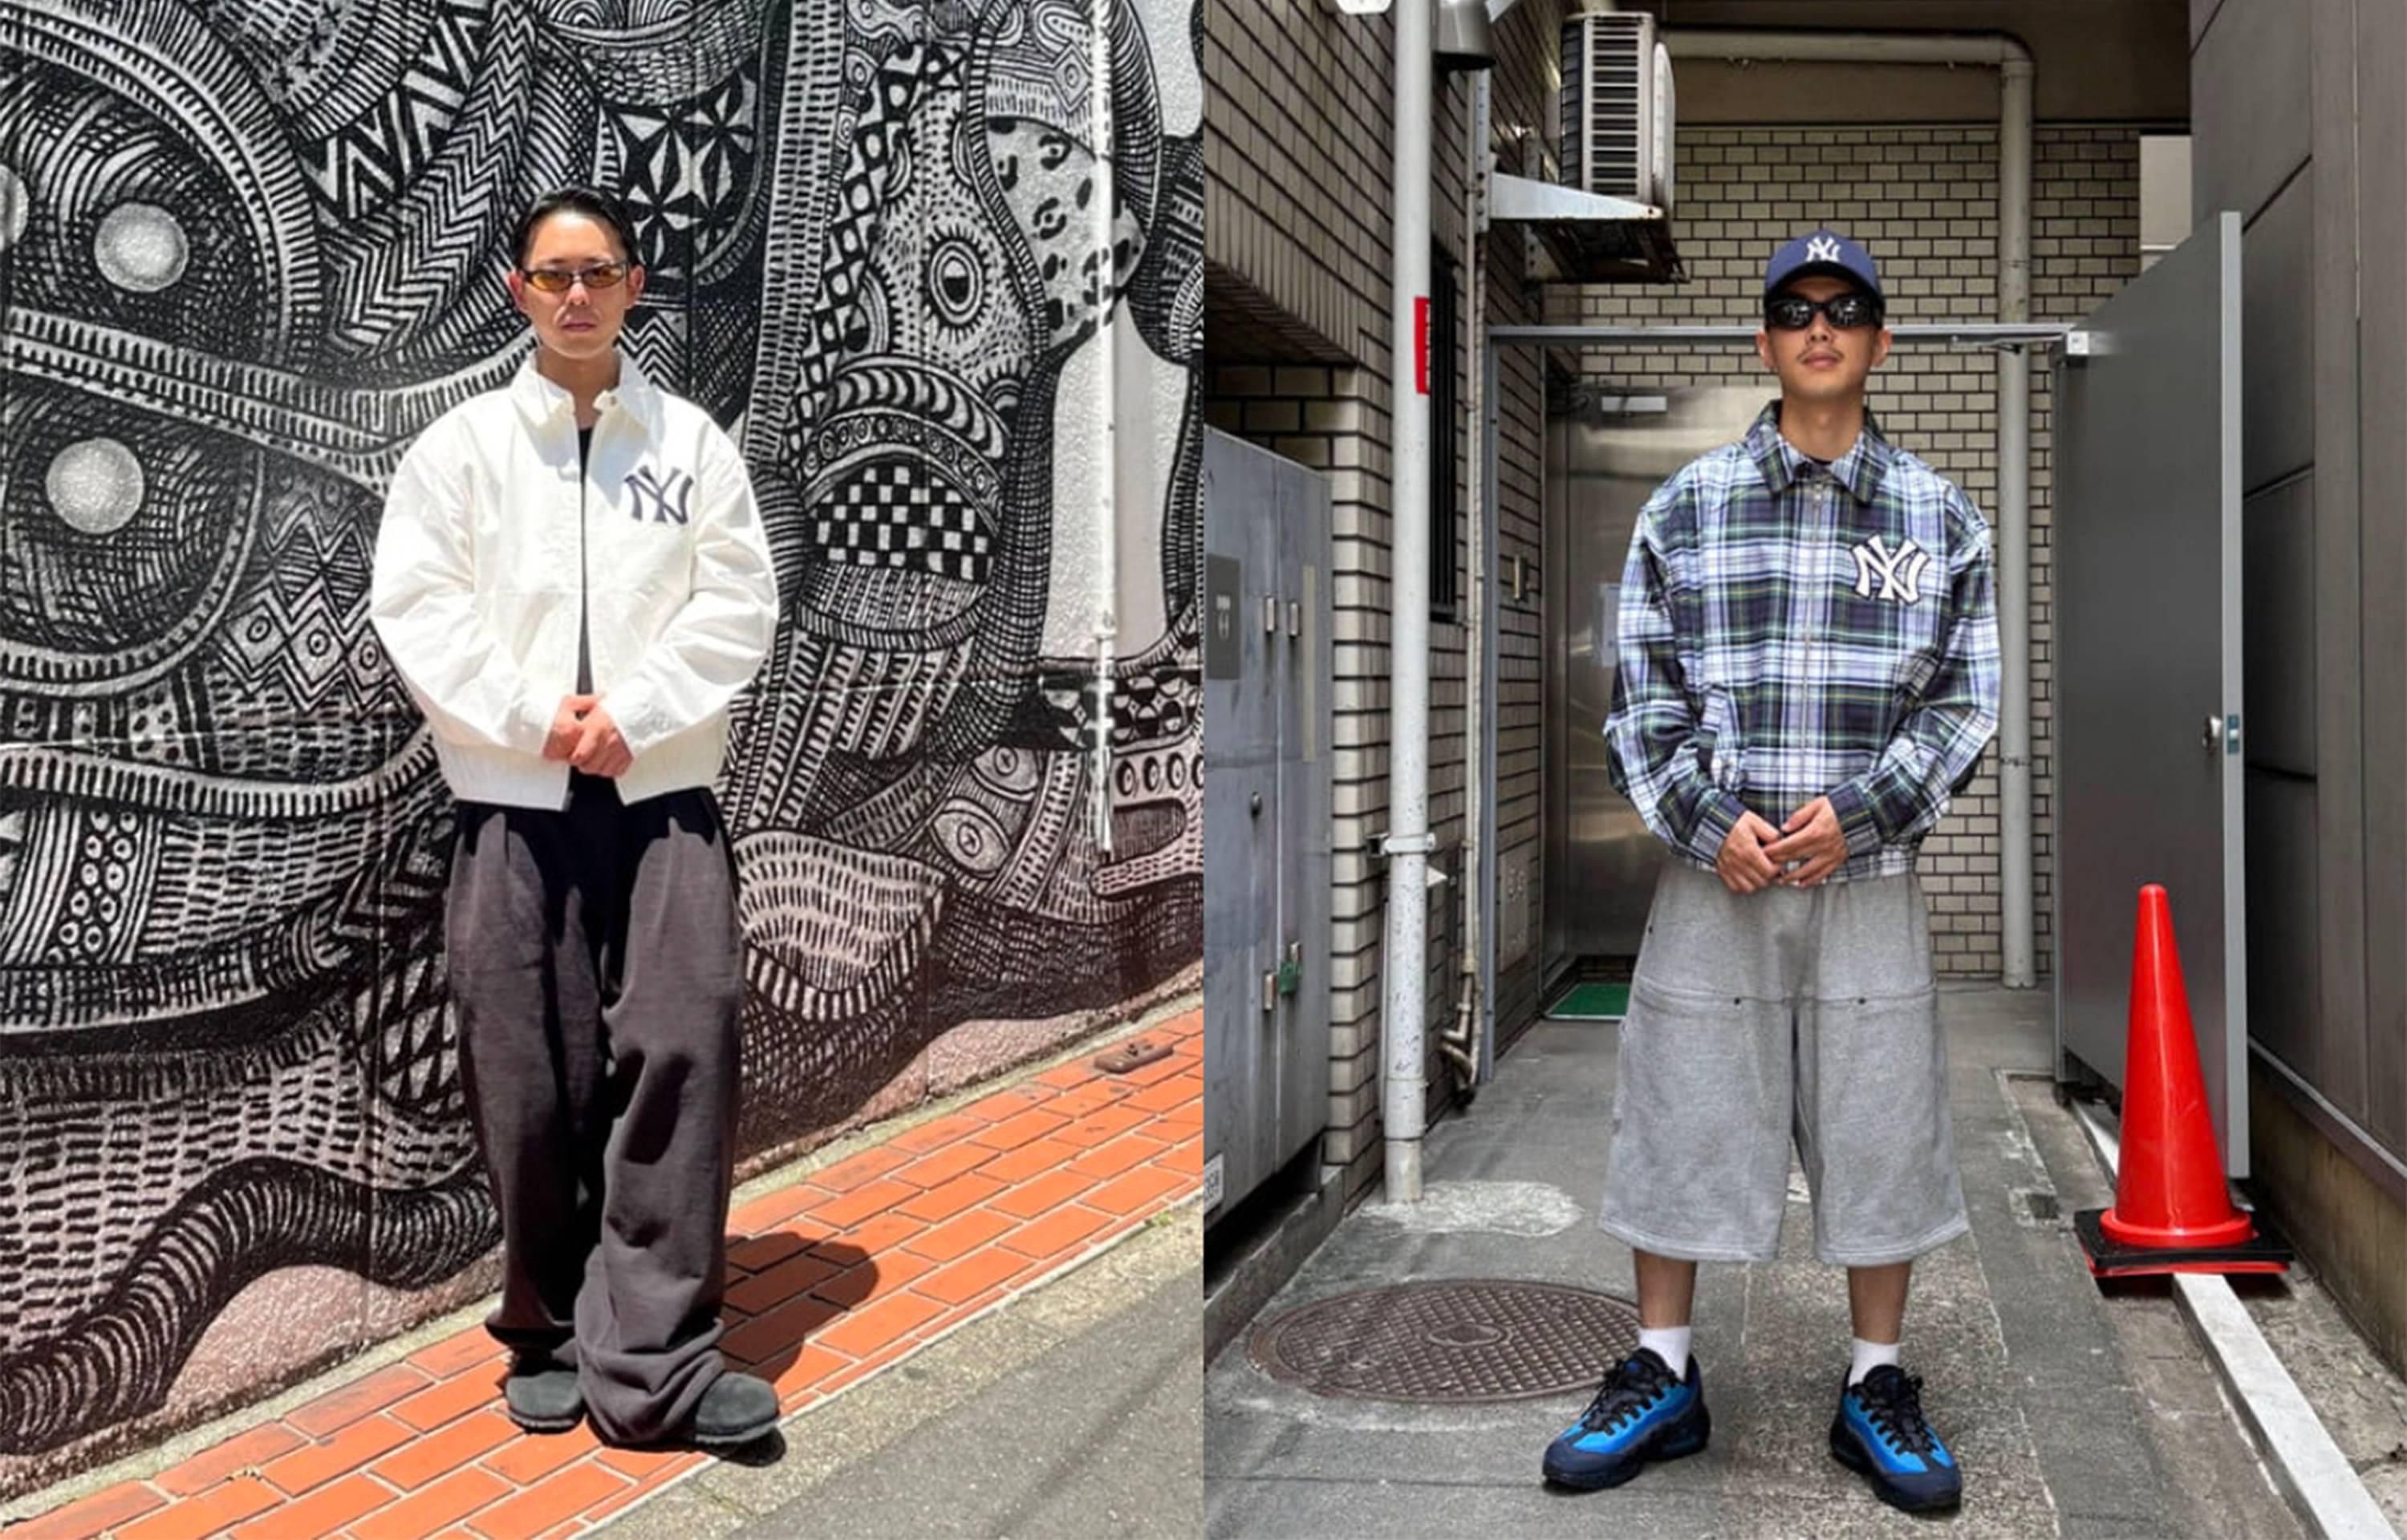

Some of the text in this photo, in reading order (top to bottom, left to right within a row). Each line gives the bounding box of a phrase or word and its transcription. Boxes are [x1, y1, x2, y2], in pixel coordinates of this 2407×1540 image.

[1806, 236, 1841, 261] NY
[624, 465, 693, 525] NY
[1851, 534, 1930, 604] NY
